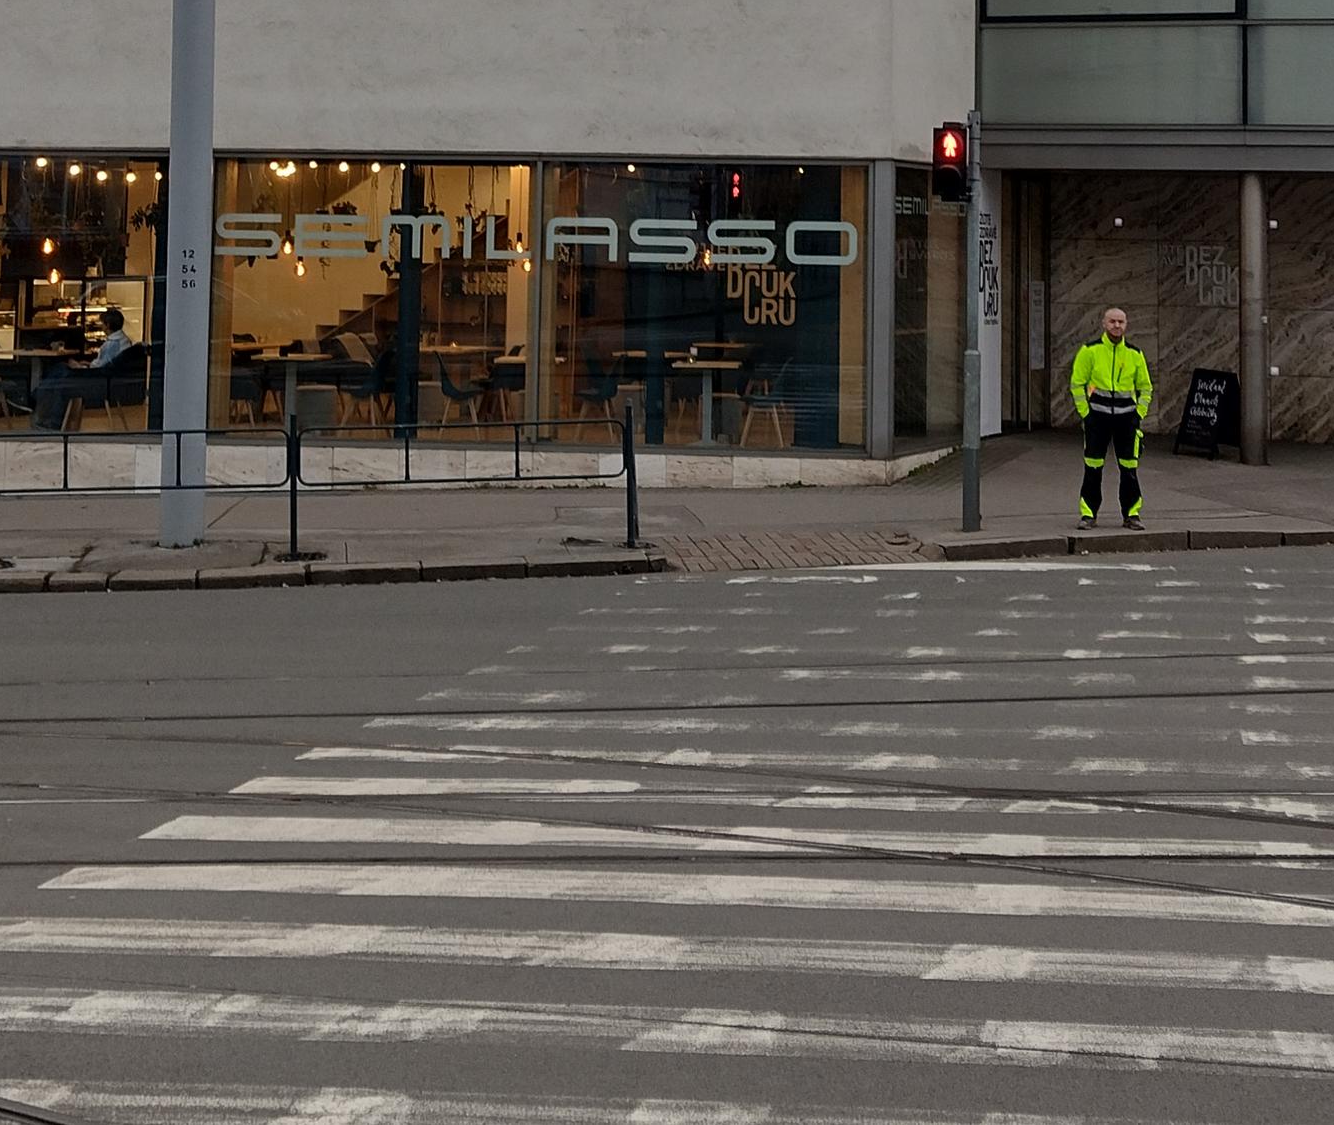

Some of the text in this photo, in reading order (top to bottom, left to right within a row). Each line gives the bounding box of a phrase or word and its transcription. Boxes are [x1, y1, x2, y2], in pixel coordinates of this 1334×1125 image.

[214, 212, 858, 266] SEMILASSO
[182, 249, 196, 259] 12
[181, 264, 197, 274] 54
